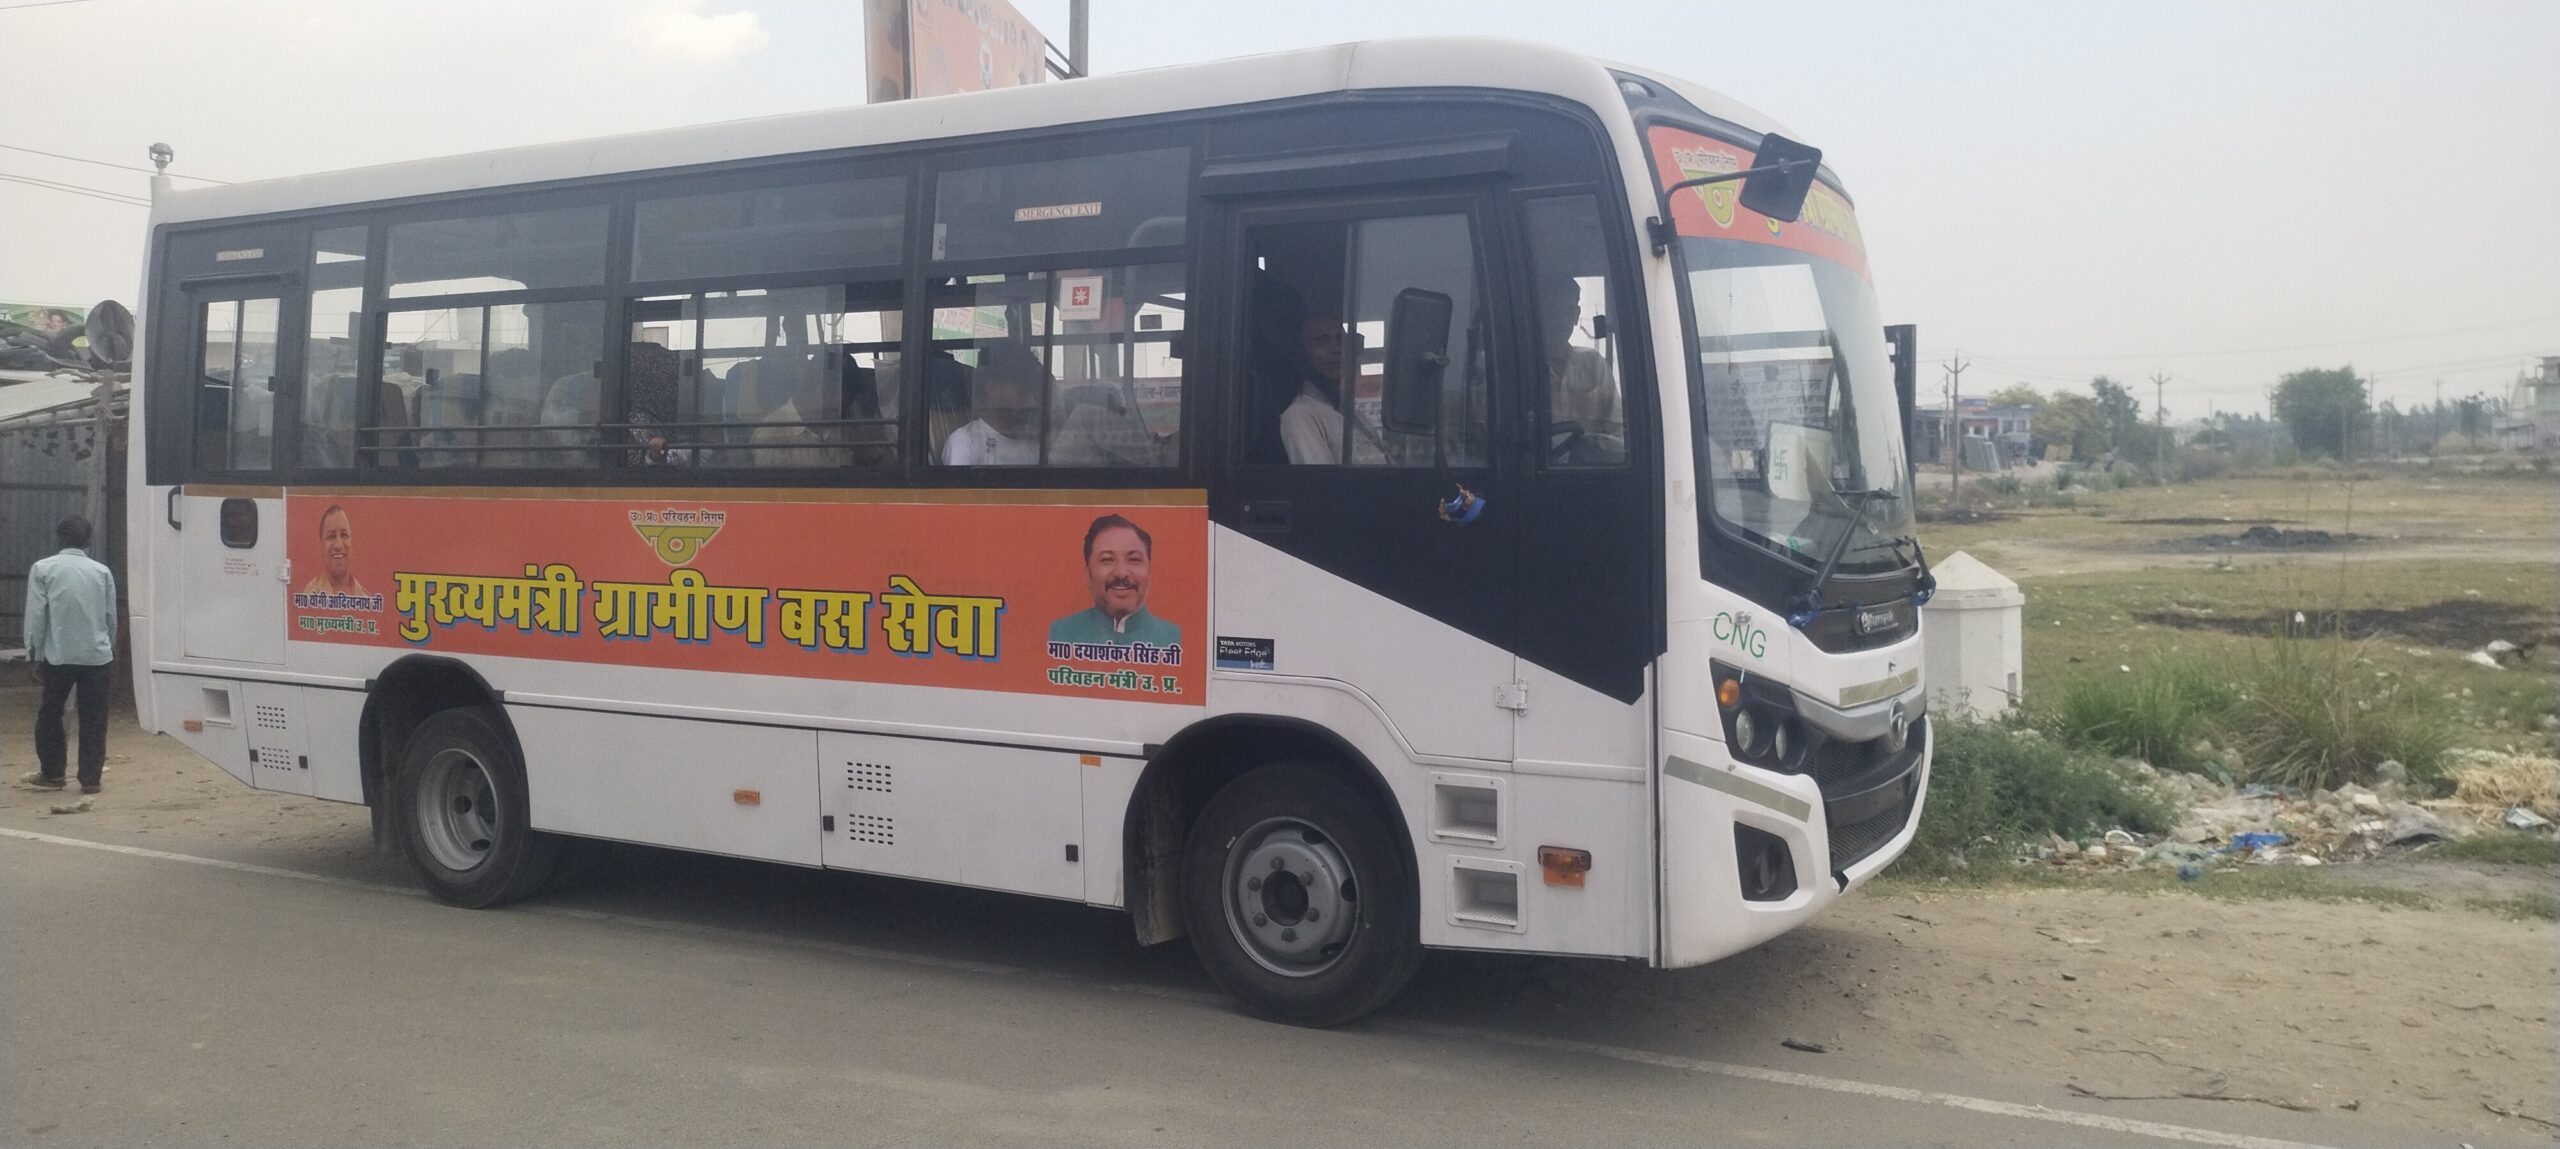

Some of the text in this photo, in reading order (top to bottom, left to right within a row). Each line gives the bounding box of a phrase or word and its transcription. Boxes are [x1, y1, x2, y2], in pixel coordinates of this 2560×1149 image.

[1017, 203, 1099, 218] EMERGENCY EXIT
[662, 509, 696, 523] परिवहन
[701, 510, 724, 523] निगम
[309, 591, 327, 608] योगी
[328, 592, 370, 611] आदित्यनाथ
[372, 594, 383, 612] जी
[394, 564, 1005, 659] मुख्यमंत्री ग्रामीण बस सेवा
[317, 616, 354, 634] मुख्यमंत्री
[1713, 611, 1767, 658] CNG
[1074, 641, 1132, 662] दयाशंकर
[1132, 642, 1160, 664] सिंह
[1162, 645, 1181, 665] जी
[1048, 667, 1105, 688] परिवहन
[1108, 670, 1138, 690] मंत्री
